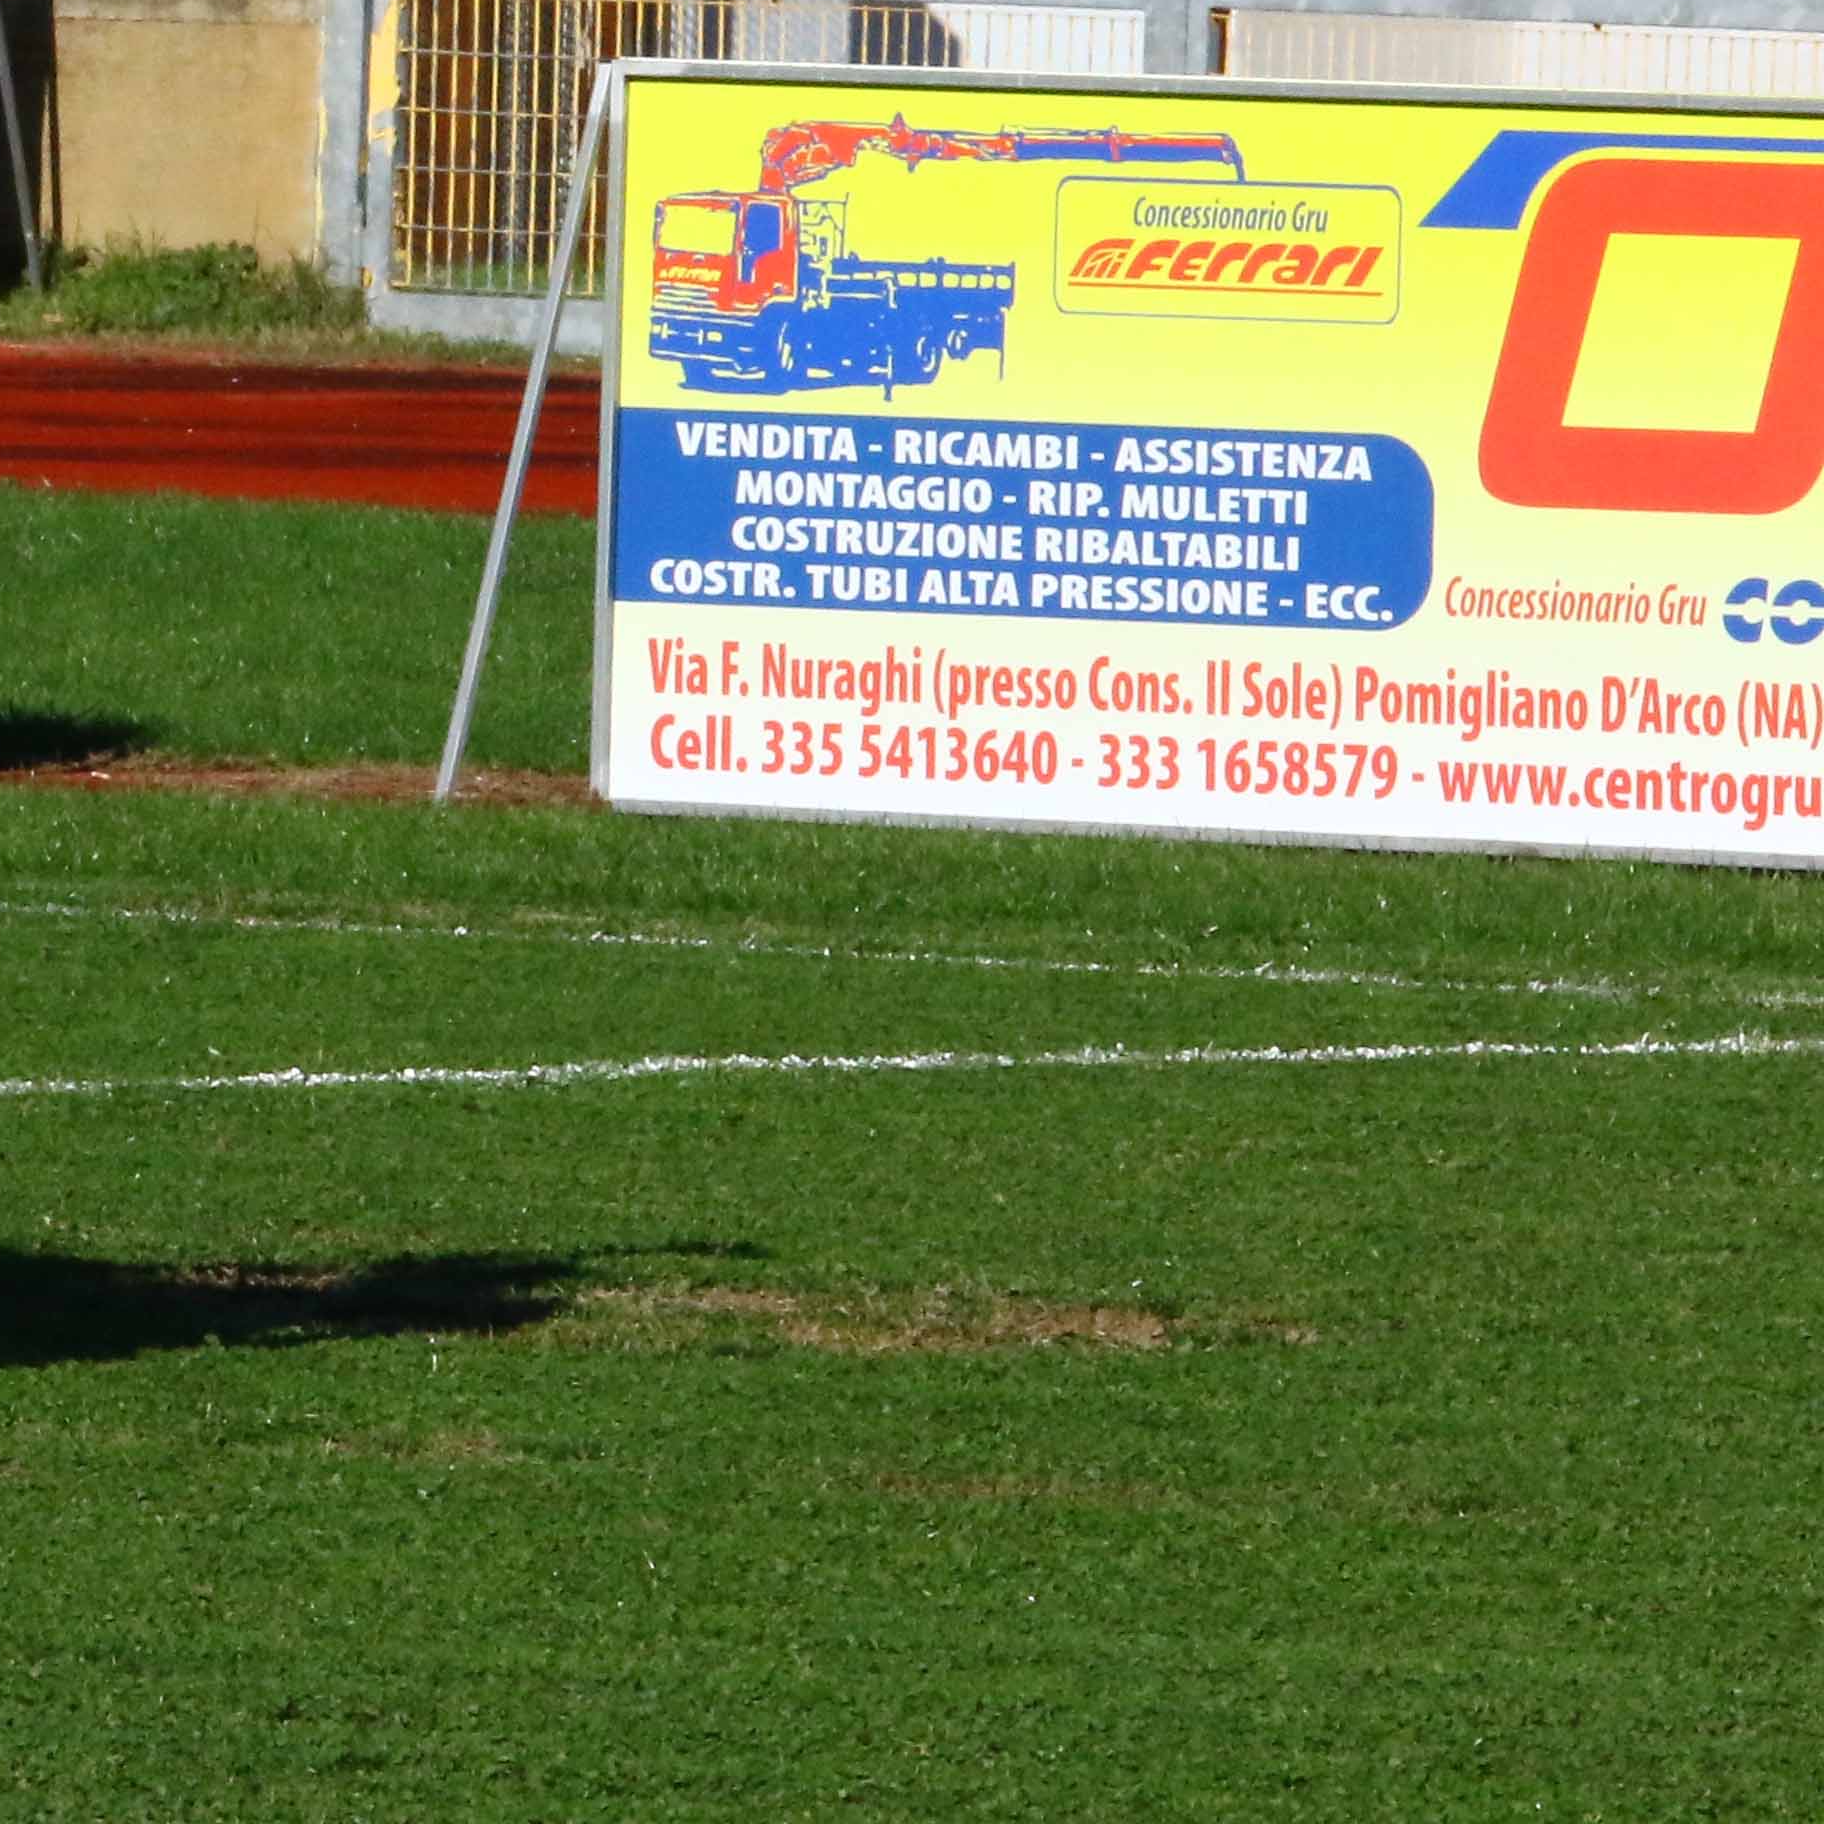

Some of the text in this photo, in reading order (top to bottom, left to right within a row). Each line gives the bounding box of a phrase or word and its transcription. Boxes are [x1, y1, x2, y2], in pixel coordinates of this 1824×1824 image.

[1133, 196, 1328, 233] Concessionario Gru
[675, 421, 858, 463] VENDITA
[894, 429, 1079, 470] RICAMBI
[1114, 437, 1373, 481] ASSISTENZA
[735, 470, 993, 514] MONTAGGIO
[1028, 480, 1110, 518] RIP.
[1120, 483, 1308, 525] MULETTI
[731, 516, 1300, 572] COSTRUZIONE RIBALTABILI
[649, 558, 797, 599] COSTR.
[805, 564, 908, 603] TUBI
[917, 568, 1020, 608] ALTA
[1031, 573, 1268, 617] PRESSIONE
[1305, 583, 1394, 623] ECC.
[1445, 576, 1651, 625] Concessionario
[1658, 584, 1707, 625] Gru
[648, 637, 709, 695] Via
[721, 640, 749, 696] F.
[761, 642, 922, 718] Nuraghi
[933, 648, 1078, 721] (presso
[1088, 655, 1194, 716] Cons.
[1242, 661, 1343, 730] Sole)
[1354, 666, 1589, 742] Pomigliano
[1601, 675, 1727, 738] D'Arco
[1738, 681, 1824, 750] (NA)
[651, 713, 748, 773] Cell.
[761, 719, 843, 776] 335
[858, 723, 1058, 785] 5413640
[1098, 733, 1181, 791] 333
[1197, 738, 1398, 800] 1658579
